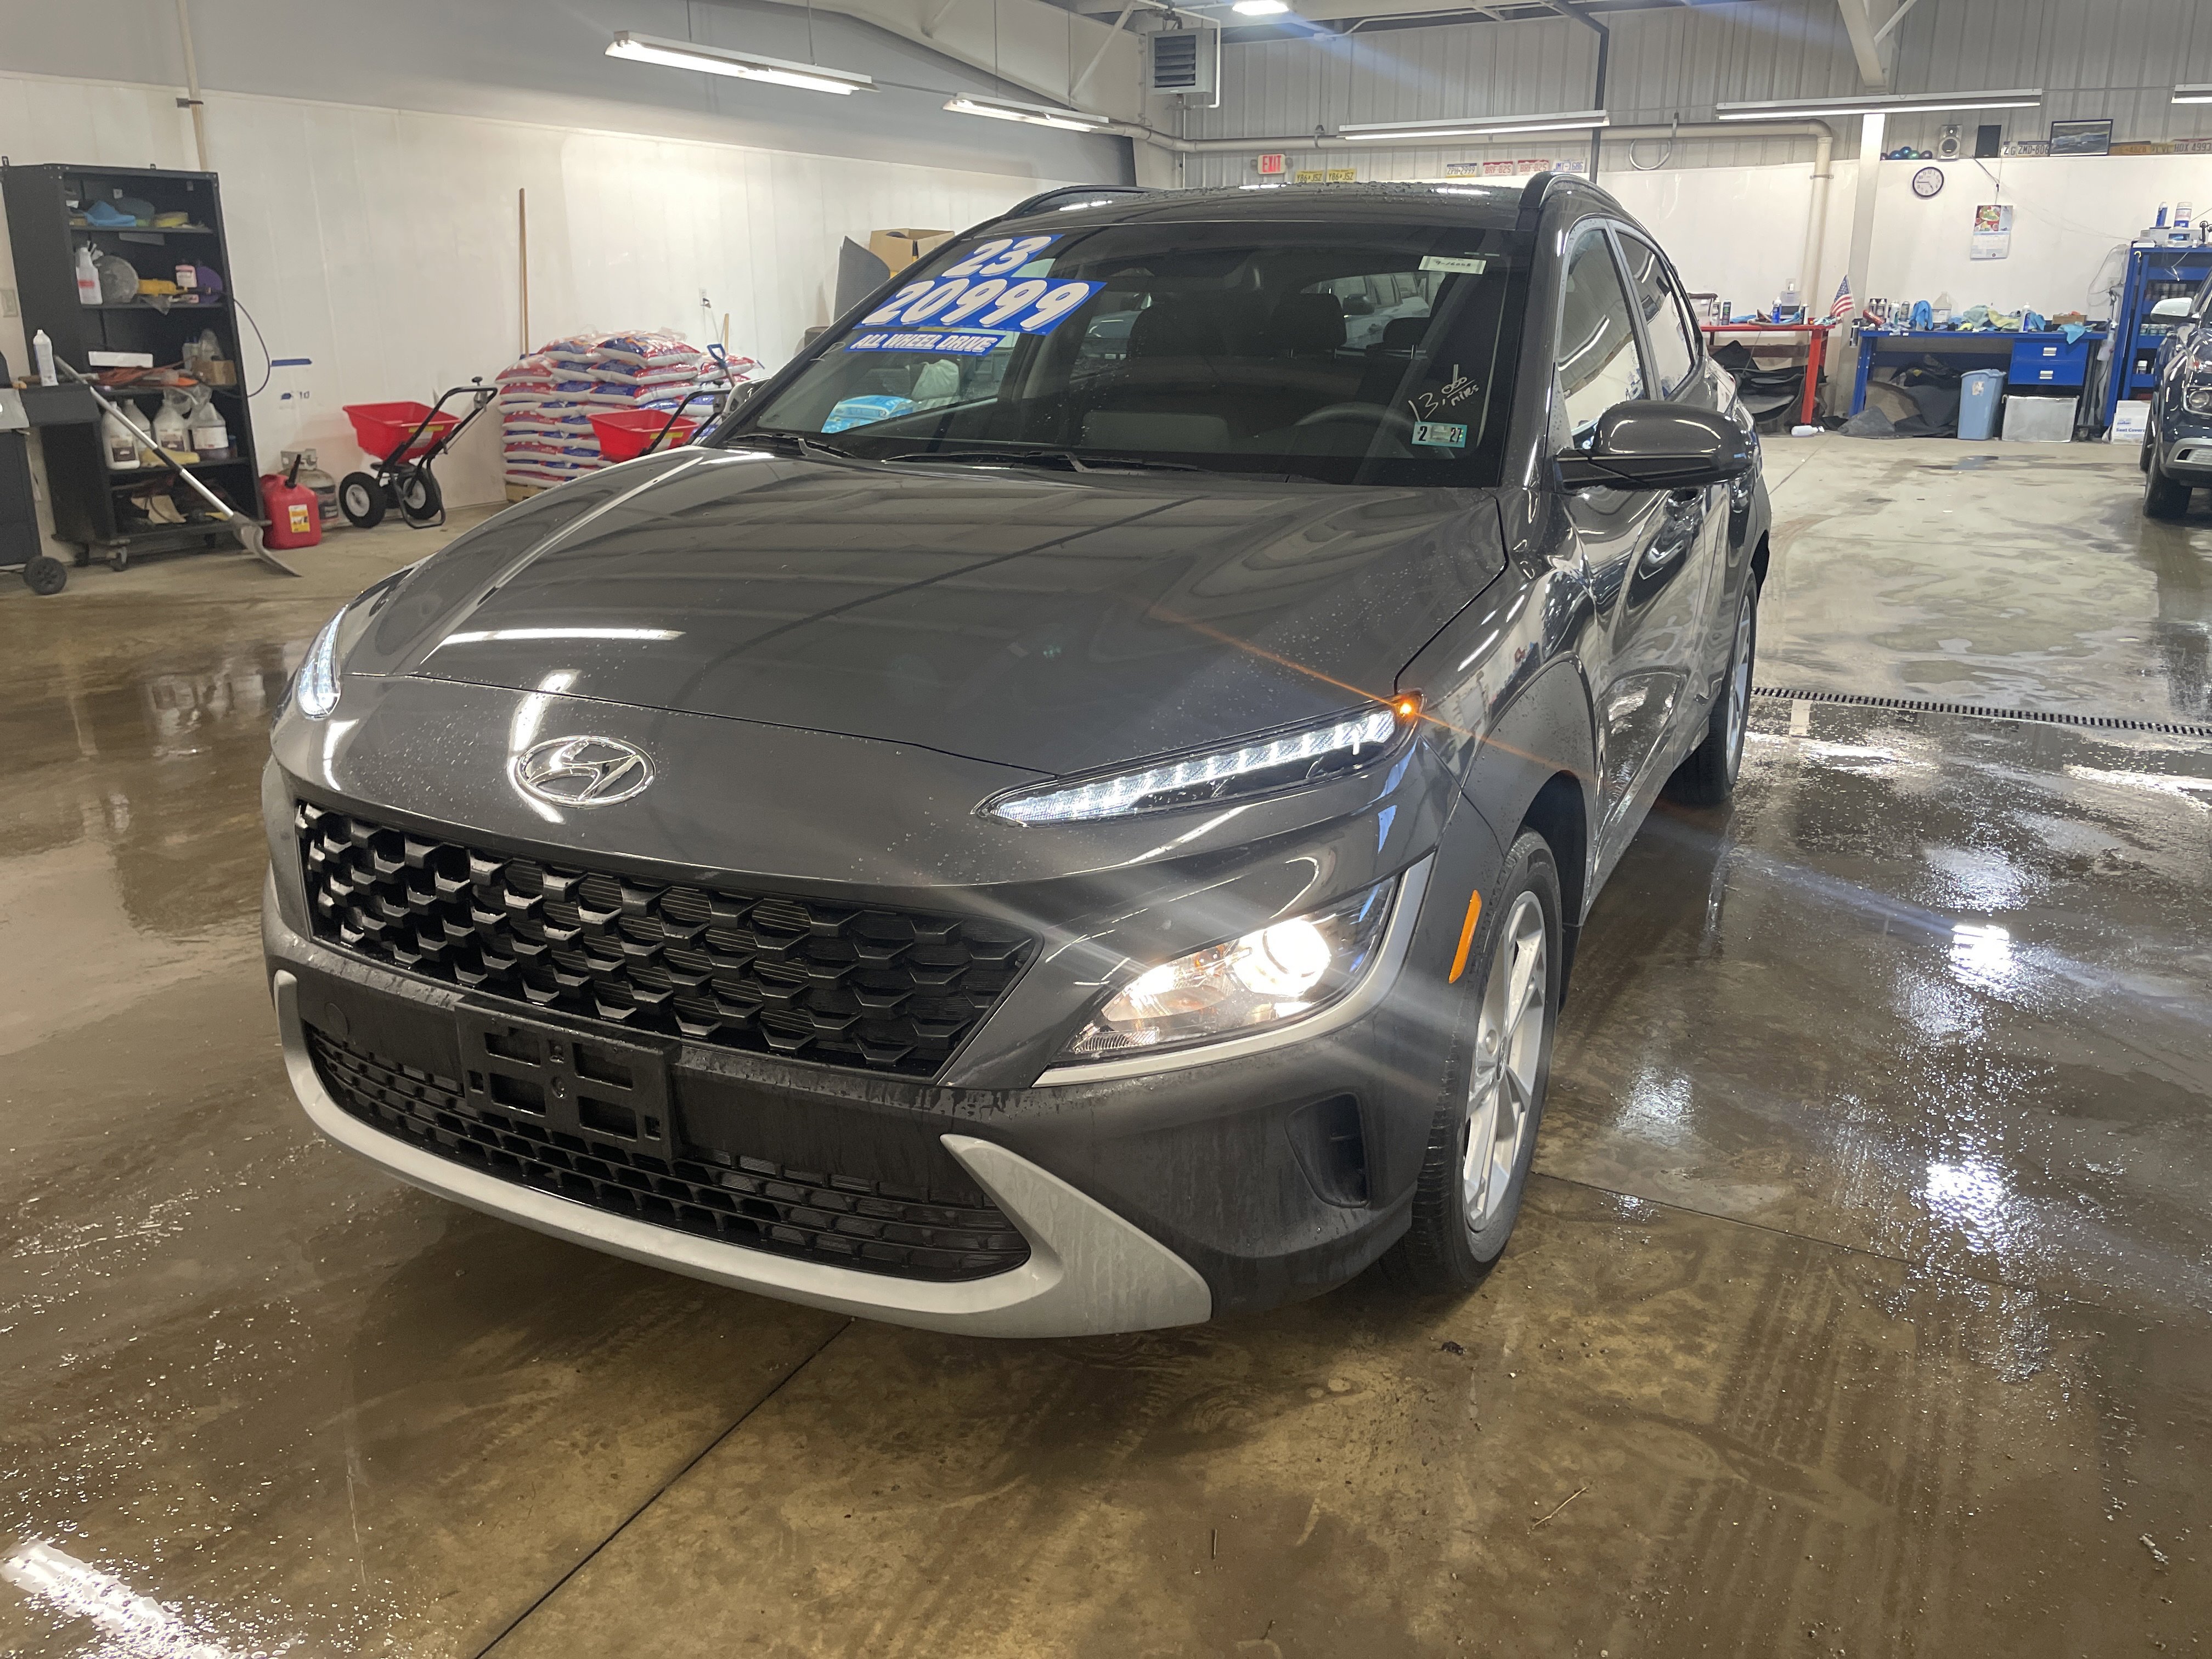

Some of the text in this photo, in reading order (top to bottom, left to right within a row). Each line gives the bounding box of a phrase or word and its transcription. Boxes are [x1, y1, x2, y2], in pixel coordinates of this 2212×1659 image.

[1263, 155, 1282, 173] EXIT
[941, 236, 1052, 278] 23
[861, 278, 1090, 331] 20999
[850, 334, 998, 352] ALL WHEEL DRIVE
[1449, 427, 1462, 444] 27
